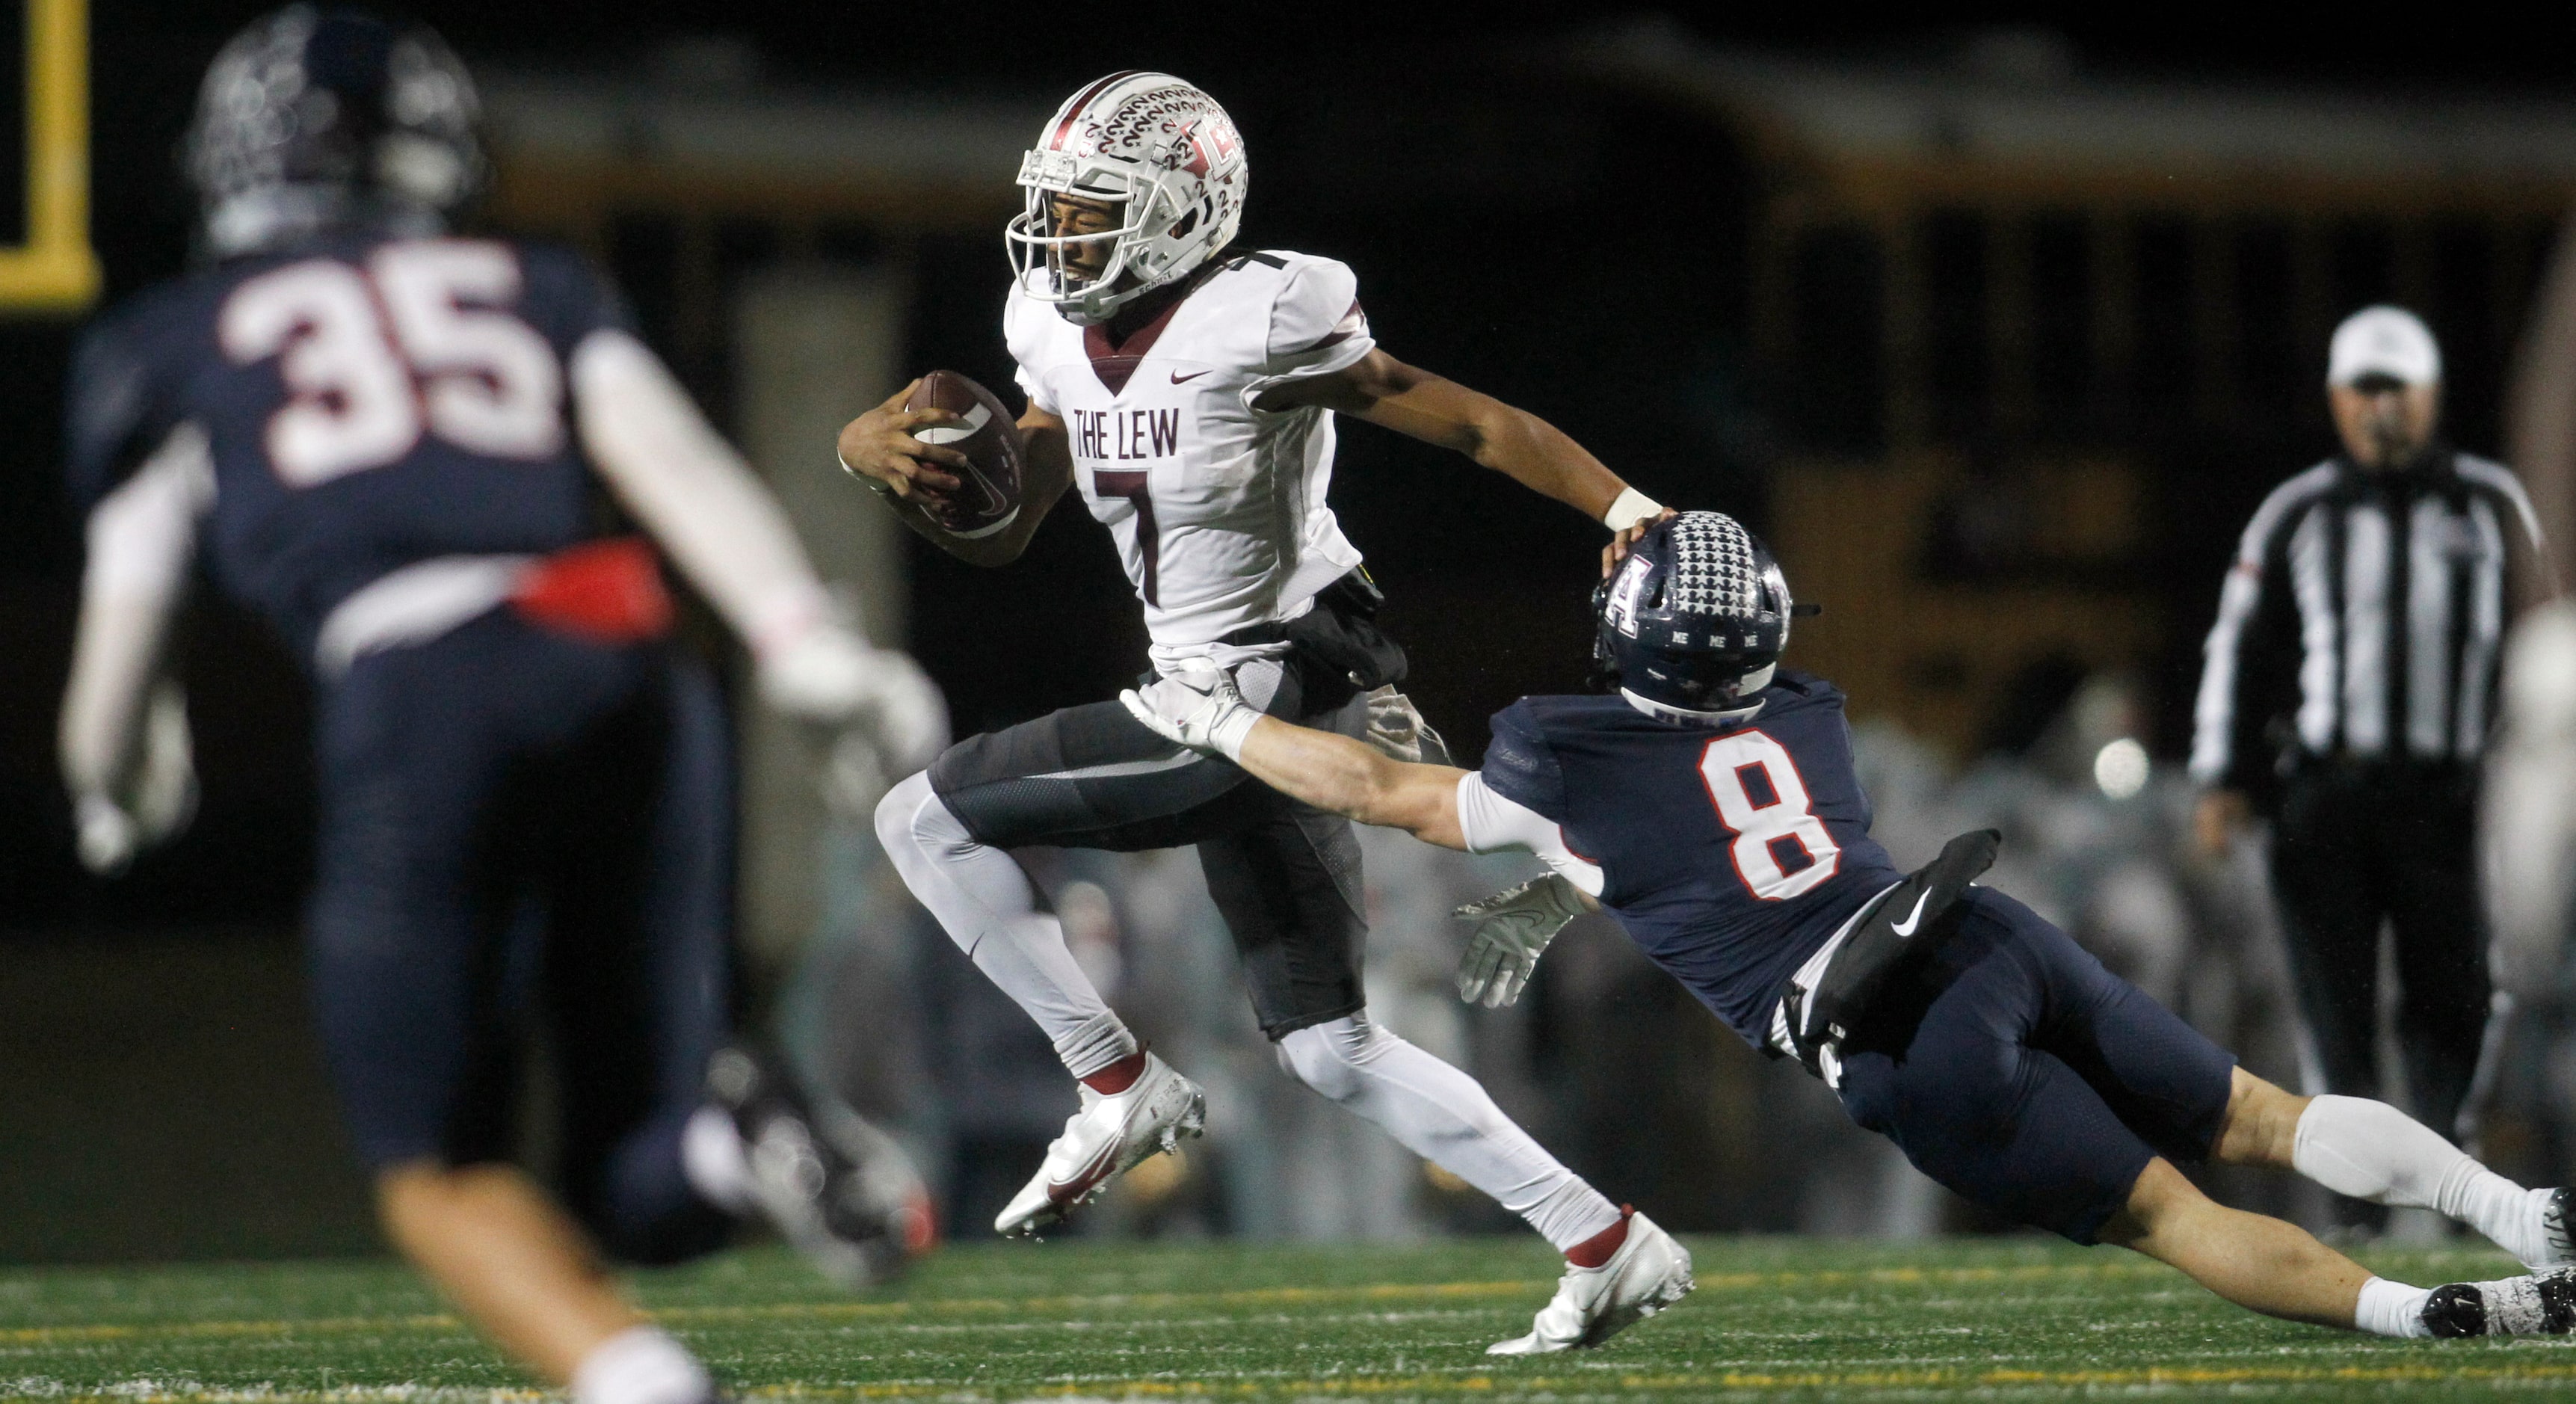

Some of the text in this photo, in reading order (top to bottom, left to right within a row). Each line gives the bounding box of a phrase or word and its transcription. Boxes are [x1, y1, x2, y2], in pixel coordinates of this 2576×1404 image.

[1085, 123, 1101, 138] 2
[1106, 119, 1125, 136] 2
[1118, 106, 1137, 120] 2
[1131, 97, 1149, 109] 2
[1148, 91, 1167, 101] 2
[1097, 135, 1115, 154] 2
[1122, 129, 1141, 148] 2
[1134, 114, 1152, 132] 2
[1147, 105, 1164, 120] 2
[1164, 102, 1181, 113] 2
[1161, 118, 1177, 134] 2
[1164, 141, 1193, 171] 2 2
[1195, 180, 1208, 198] 2
[1218, 189, 1230, 208] 2
[215, 238, 566, 490] 35
[1073, 407, 1180, 460] THE LEW
[1091, 467, 1165, 612] 7
[1604, 553, 1654, 639] A
[1671, 630, 1758, 648] ME ME ME
[1696, 726, 1841, 902] 8
